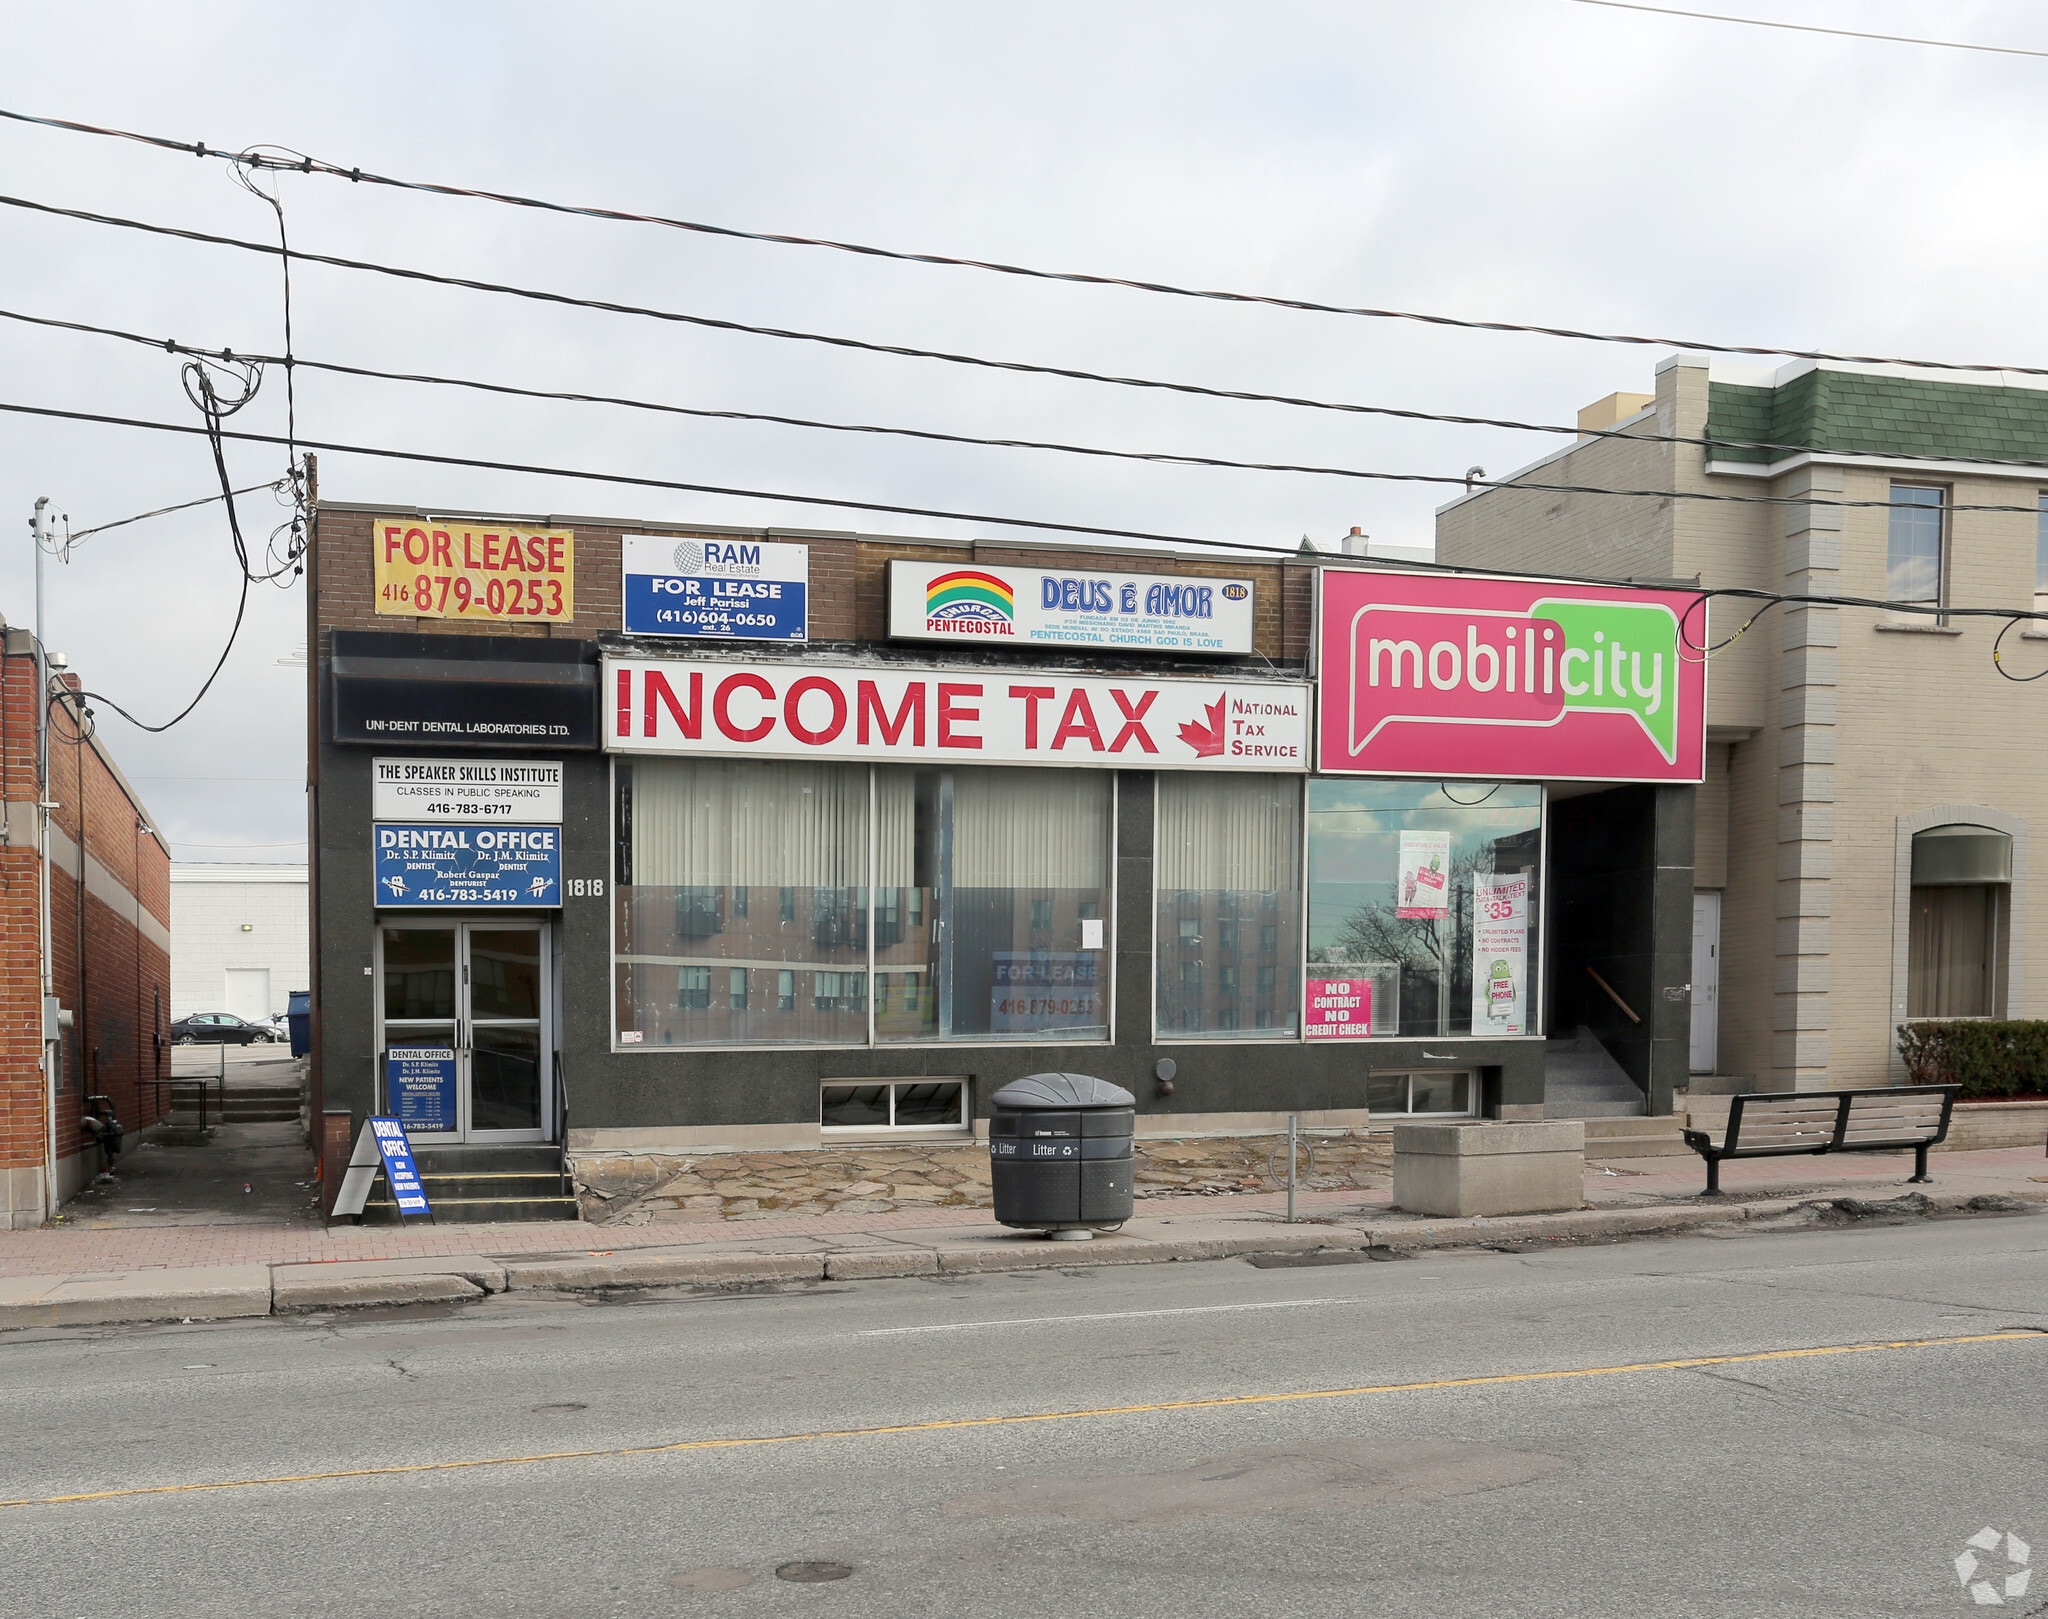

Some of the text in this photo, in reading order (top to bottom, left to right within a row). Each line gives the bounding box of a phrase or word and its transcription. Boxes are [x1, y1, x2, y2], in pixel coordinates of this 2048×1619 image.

[384, 526, 565, 573] FOR LEASE
[704, 543, 760, 565] RAM
[704, 562, 760, 574] Real Estate
[382, 574, 563, 616] 416 879-0253
[652, 578, 782, 599] FOR LEASE
[1224, 586, 1246, 599] 1818
[684, 596, 750, 609] Jeff Parissi
[1040, 576, 1214, 620] DEUS É AMOR
[656, 608, 776, 627] (416)604-0650
[939, 603, 1003, 621] CHURCH
[702, 624, 731, 632] ext. 26
[926, 619, 1015, 636] PENTECOSTAL
[1030, 630, 1223, 648] PENTECOSTAL CHURCH GOD IS LOVE
[1369, 624, 1663, 716] mobilicity
[616, 668, 1161, 754] INCOME TAX
[1231, 698, 1298, 716] NATIONAL
[365, 719, 570, 736] UNI-DENT DENTAL LABORATORIES LTD.
[1232, 719, 1265, 736] TAX
[1231, 739, 1298, 758] SERVICE
[378, 764, 559, 783] THE SPEAKER SKILLS INSTITUTE
[396, 786, 540, 798] CLASSES IN PUBLIC SPEAKING
[427, 803, 512, 815] 416-783-6717
[380, 830, 554, 850] DENTAL OFFICE
[386, 850, 456, 861] Dr. S.P. Klimitz
[477, 851, 549, 861] Dr. J.M. Klimitz
[406, 862, 435, 870] DENTIST
[499, 863, 527, 871] DENTIST
[437, 870, 500, 881] Robert Gaspar
[418, 888, 518, 901] 416-783-5419
[567, 879, 604, 897] 1818
[1476, 882, 1526, 897] UNLIMITED
[1510, 890, 1525, 899] TEXT
[996, 965, 1098, 981] FOR LEASE
[1325, 982, 1350, 995] NO
[1493, 980, 1508, 990] FREE
[1491, 990, 1512, 1000] PHONE
[1314, 996, 1361, 1009] CONTRACT
[1324, 1010, 1350, 1022] NO
[1305, 1023, 1368, 1036] CREDIT CHECK
[392, 1050, 451, 1059] DENTAL OFFICE
[372, 1121, 403, 1137] DENTAL
[381, 1140, 408, 1157] OFFICE
[999, 1142, 1016, 1154] Litter
[1033, 1143, 1057, 1156] Litter
